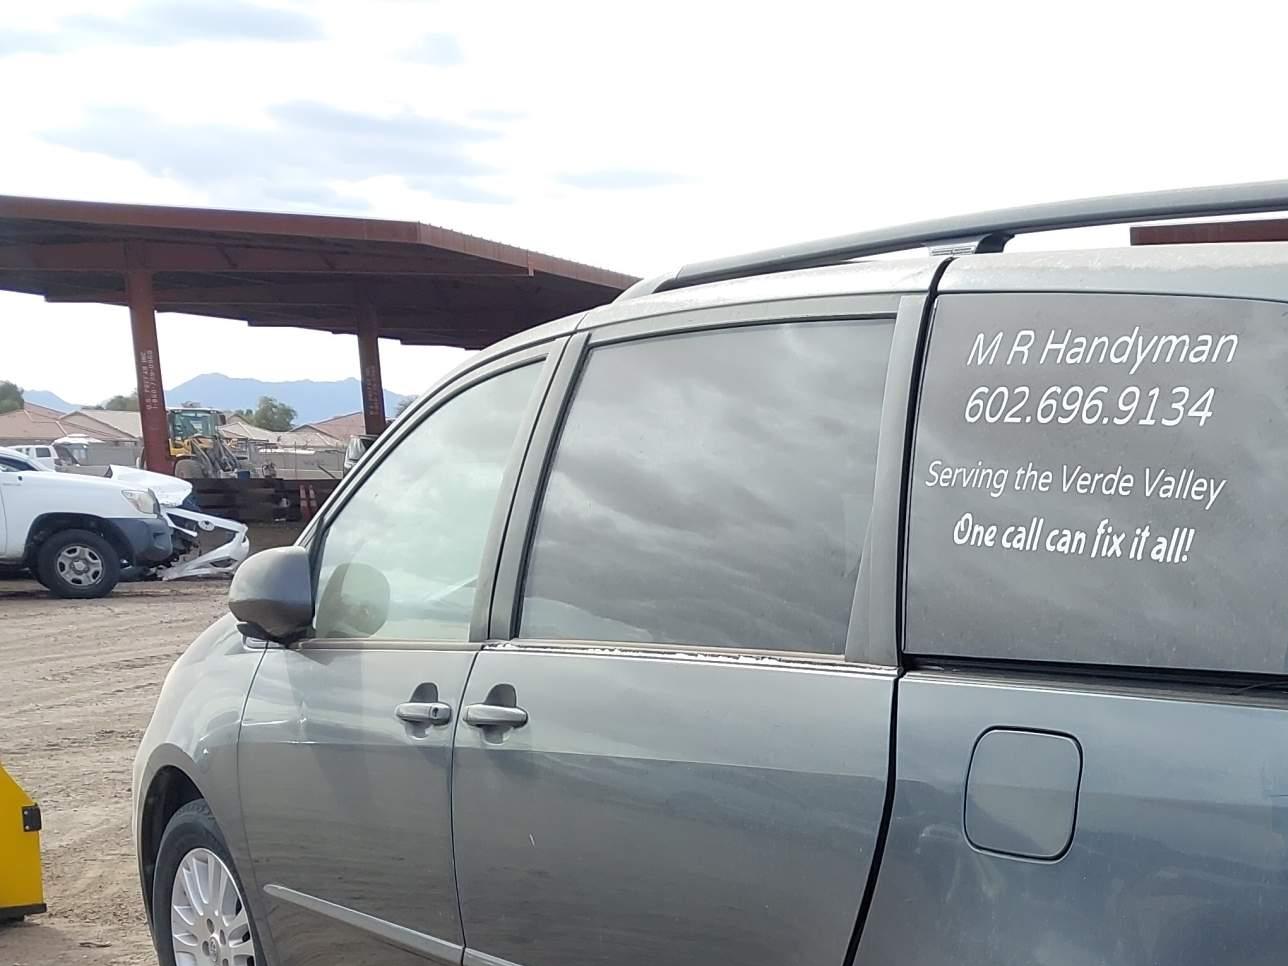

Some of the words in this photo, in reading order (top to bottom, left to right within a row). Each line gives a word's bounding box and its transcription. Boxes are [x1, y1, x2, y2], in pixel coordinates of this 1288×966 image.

[967, 331, 1004, 366] M
[1006, 329, 1036, 365] R
[1039, 326, 1239, 375] Handyman
[964, 385, 1216, 427] 602.696.9134
[925, 460, 1009, 497] Serving
[1013, 462, 1053, 492] the
[1060, 464, 1134, 496] Verde
[1143, 467, 1227, 511] Valley
[952, 512, 996, 547] One
[1001, 517, 1045, 551] call
[1045, 527, 1087, 554] can
[1090, 518, 1126, 559] fix
[1129, 522, 1151, 561] it
[1150, 527, 1195, 564] all!
